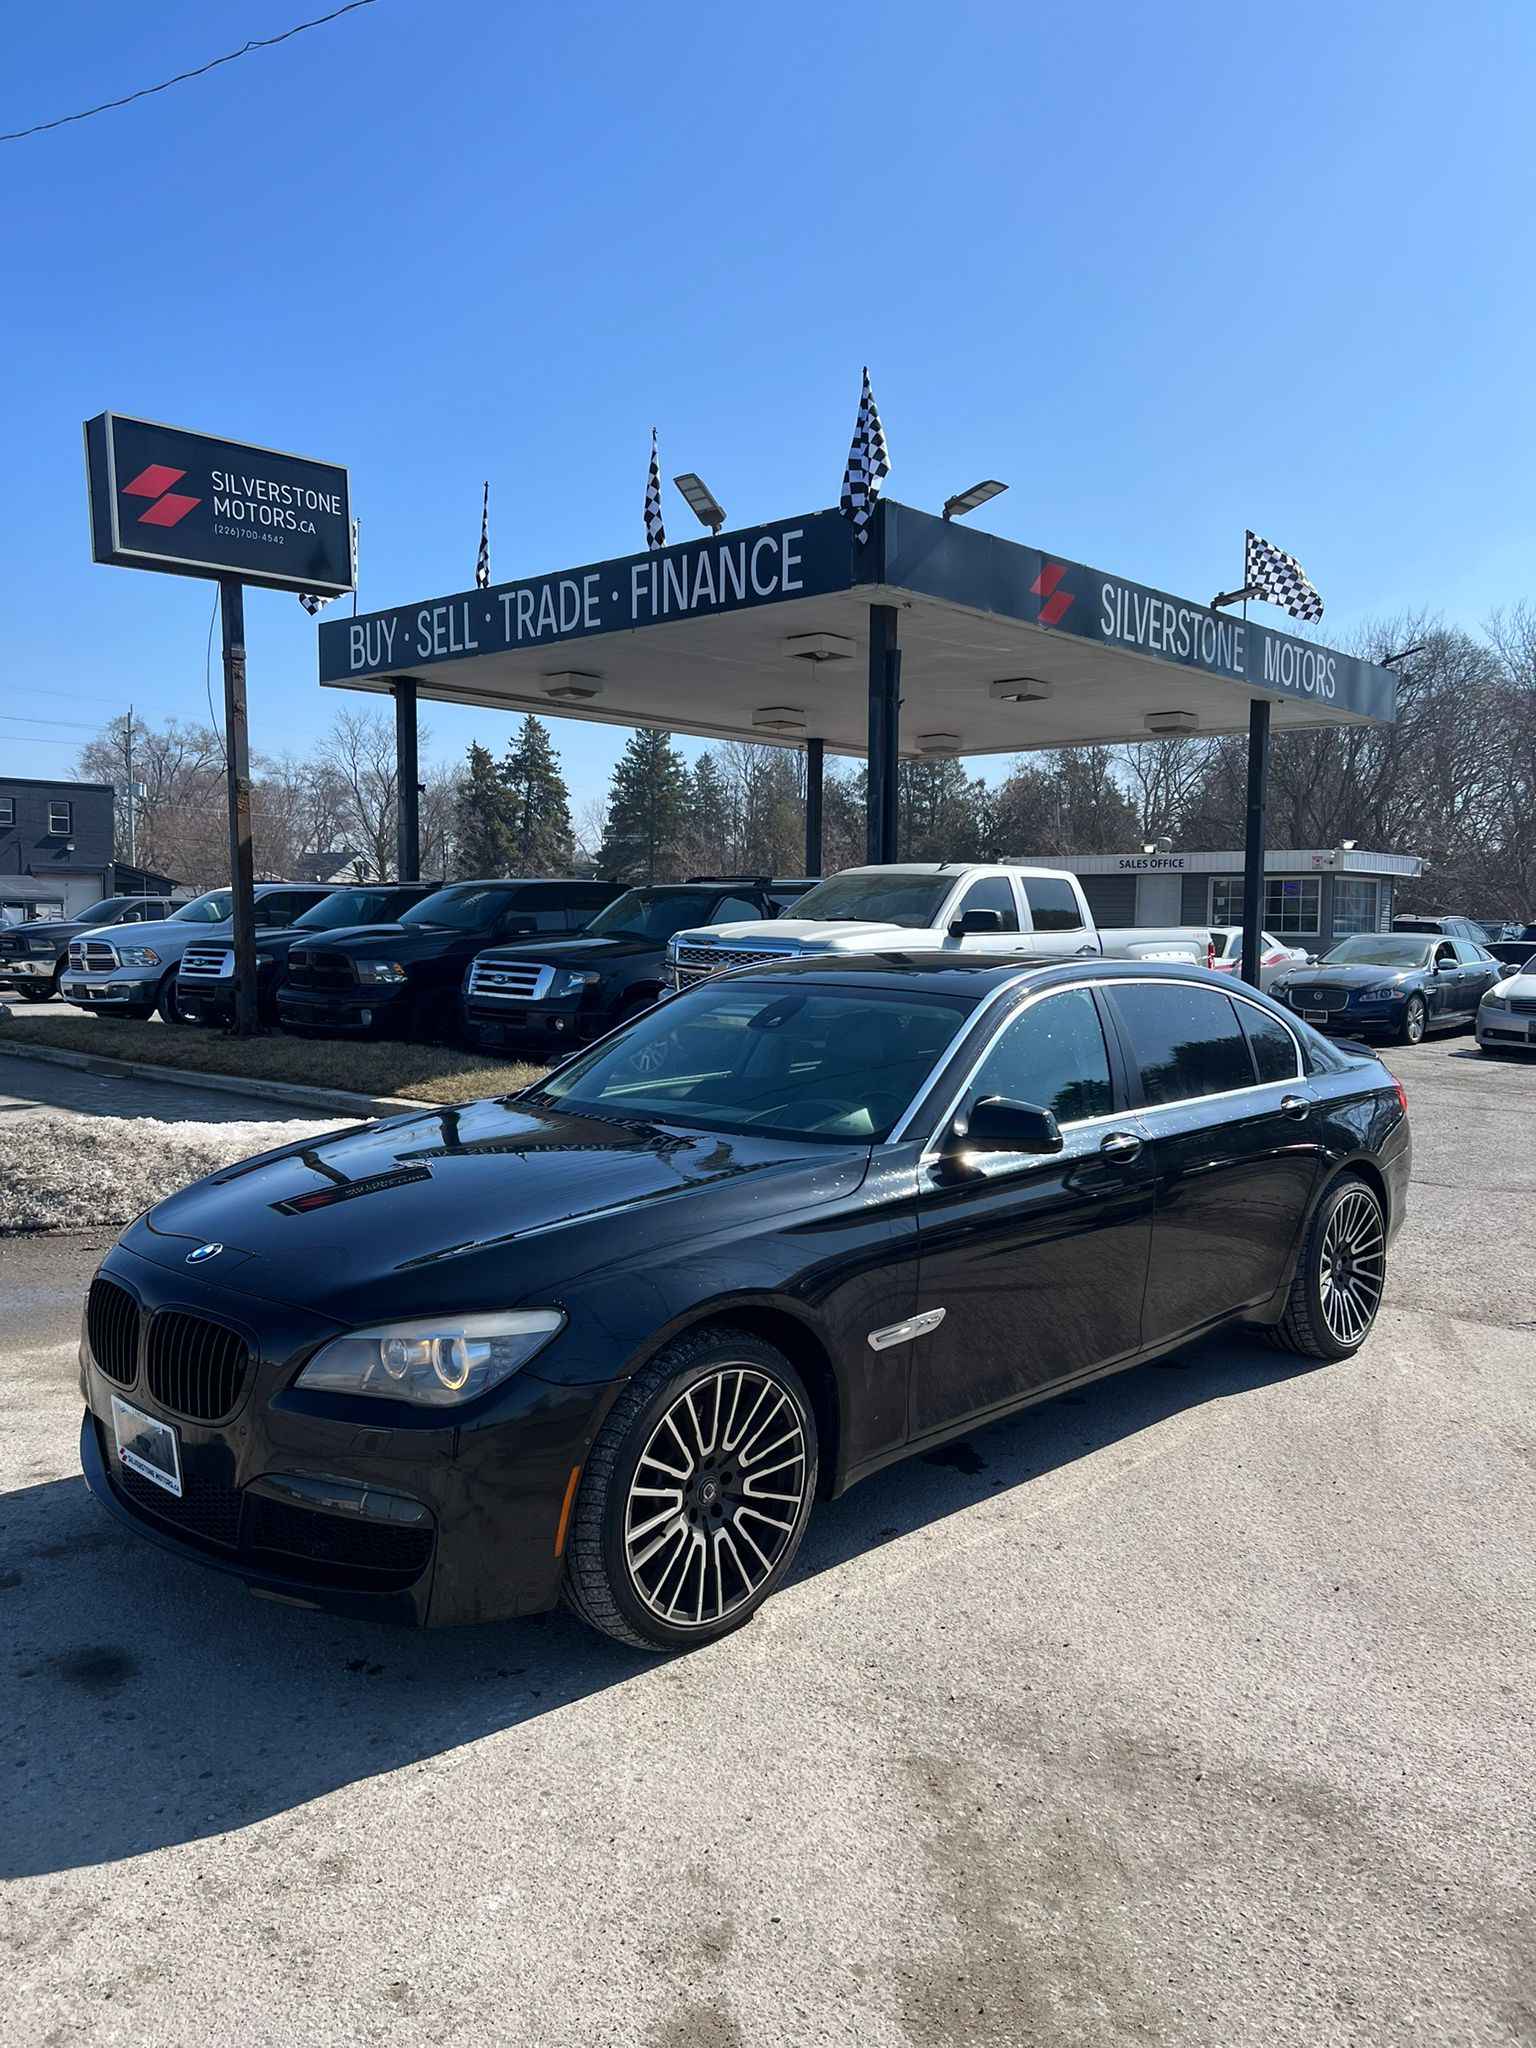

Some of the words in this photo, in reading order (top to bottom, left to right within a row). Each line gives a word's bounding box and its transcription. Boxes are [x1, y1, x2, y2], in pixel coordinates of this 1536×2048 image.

[211, 470, 342, 515] SILVERSTONE
[213, 495, 317, 535] MOTORS.CA
[214, 523, 285, 545] (226)700-4542
[350, 616, 397, 670] BUY
[416, 600, 478, 658] SELL
[499, 574, 601, 642] TRADE
[631, 529, 804, 619] FINANCE
[1100, 583, 1246, 673] SILVERSTONE
[1263, 636, 1336, 698] MOTORS
[1119, 858, 1148, 869] SALES
[1150, 858, 1184, 868] OFFICE
